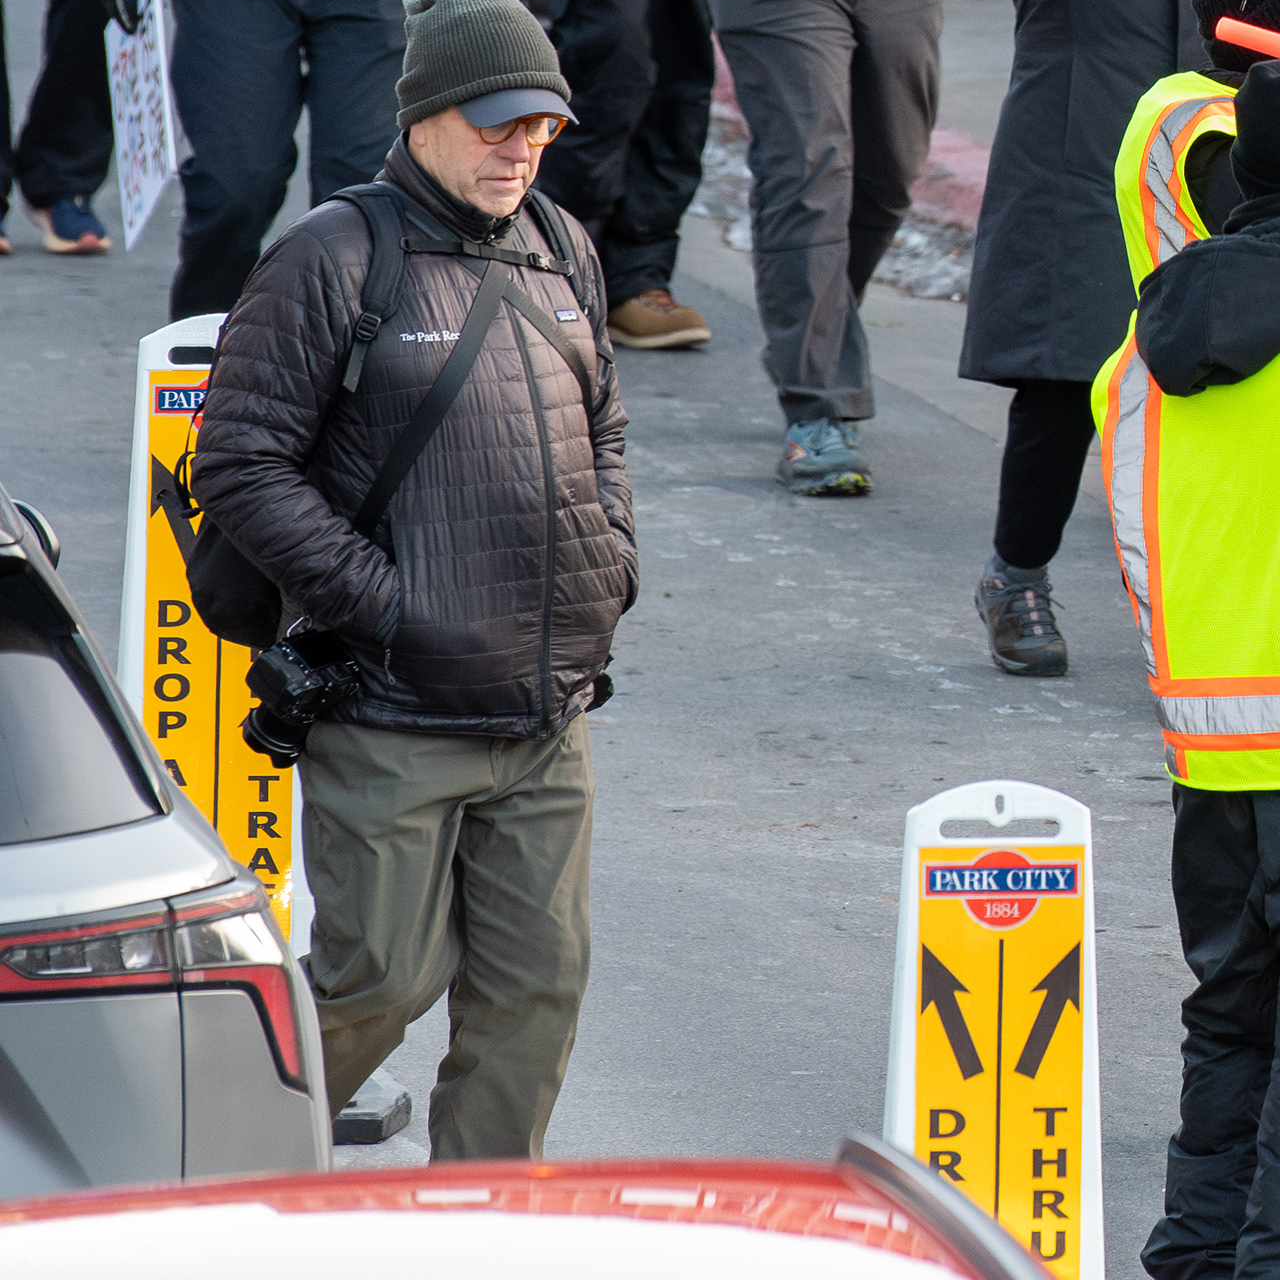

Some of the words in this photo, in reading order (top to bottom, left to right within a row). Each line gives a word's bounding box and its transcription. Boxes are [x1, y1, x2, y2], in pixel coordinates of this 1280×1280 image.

[400, 333, 415, 341] The
[417, 331, 441, 342] Park
[161, 391, 207, 409] PAR
[931, 869, 1000, 893] PARK
[1006, 867, 1072, 891] CITY
[983, 901, 1021, 919] 1884
